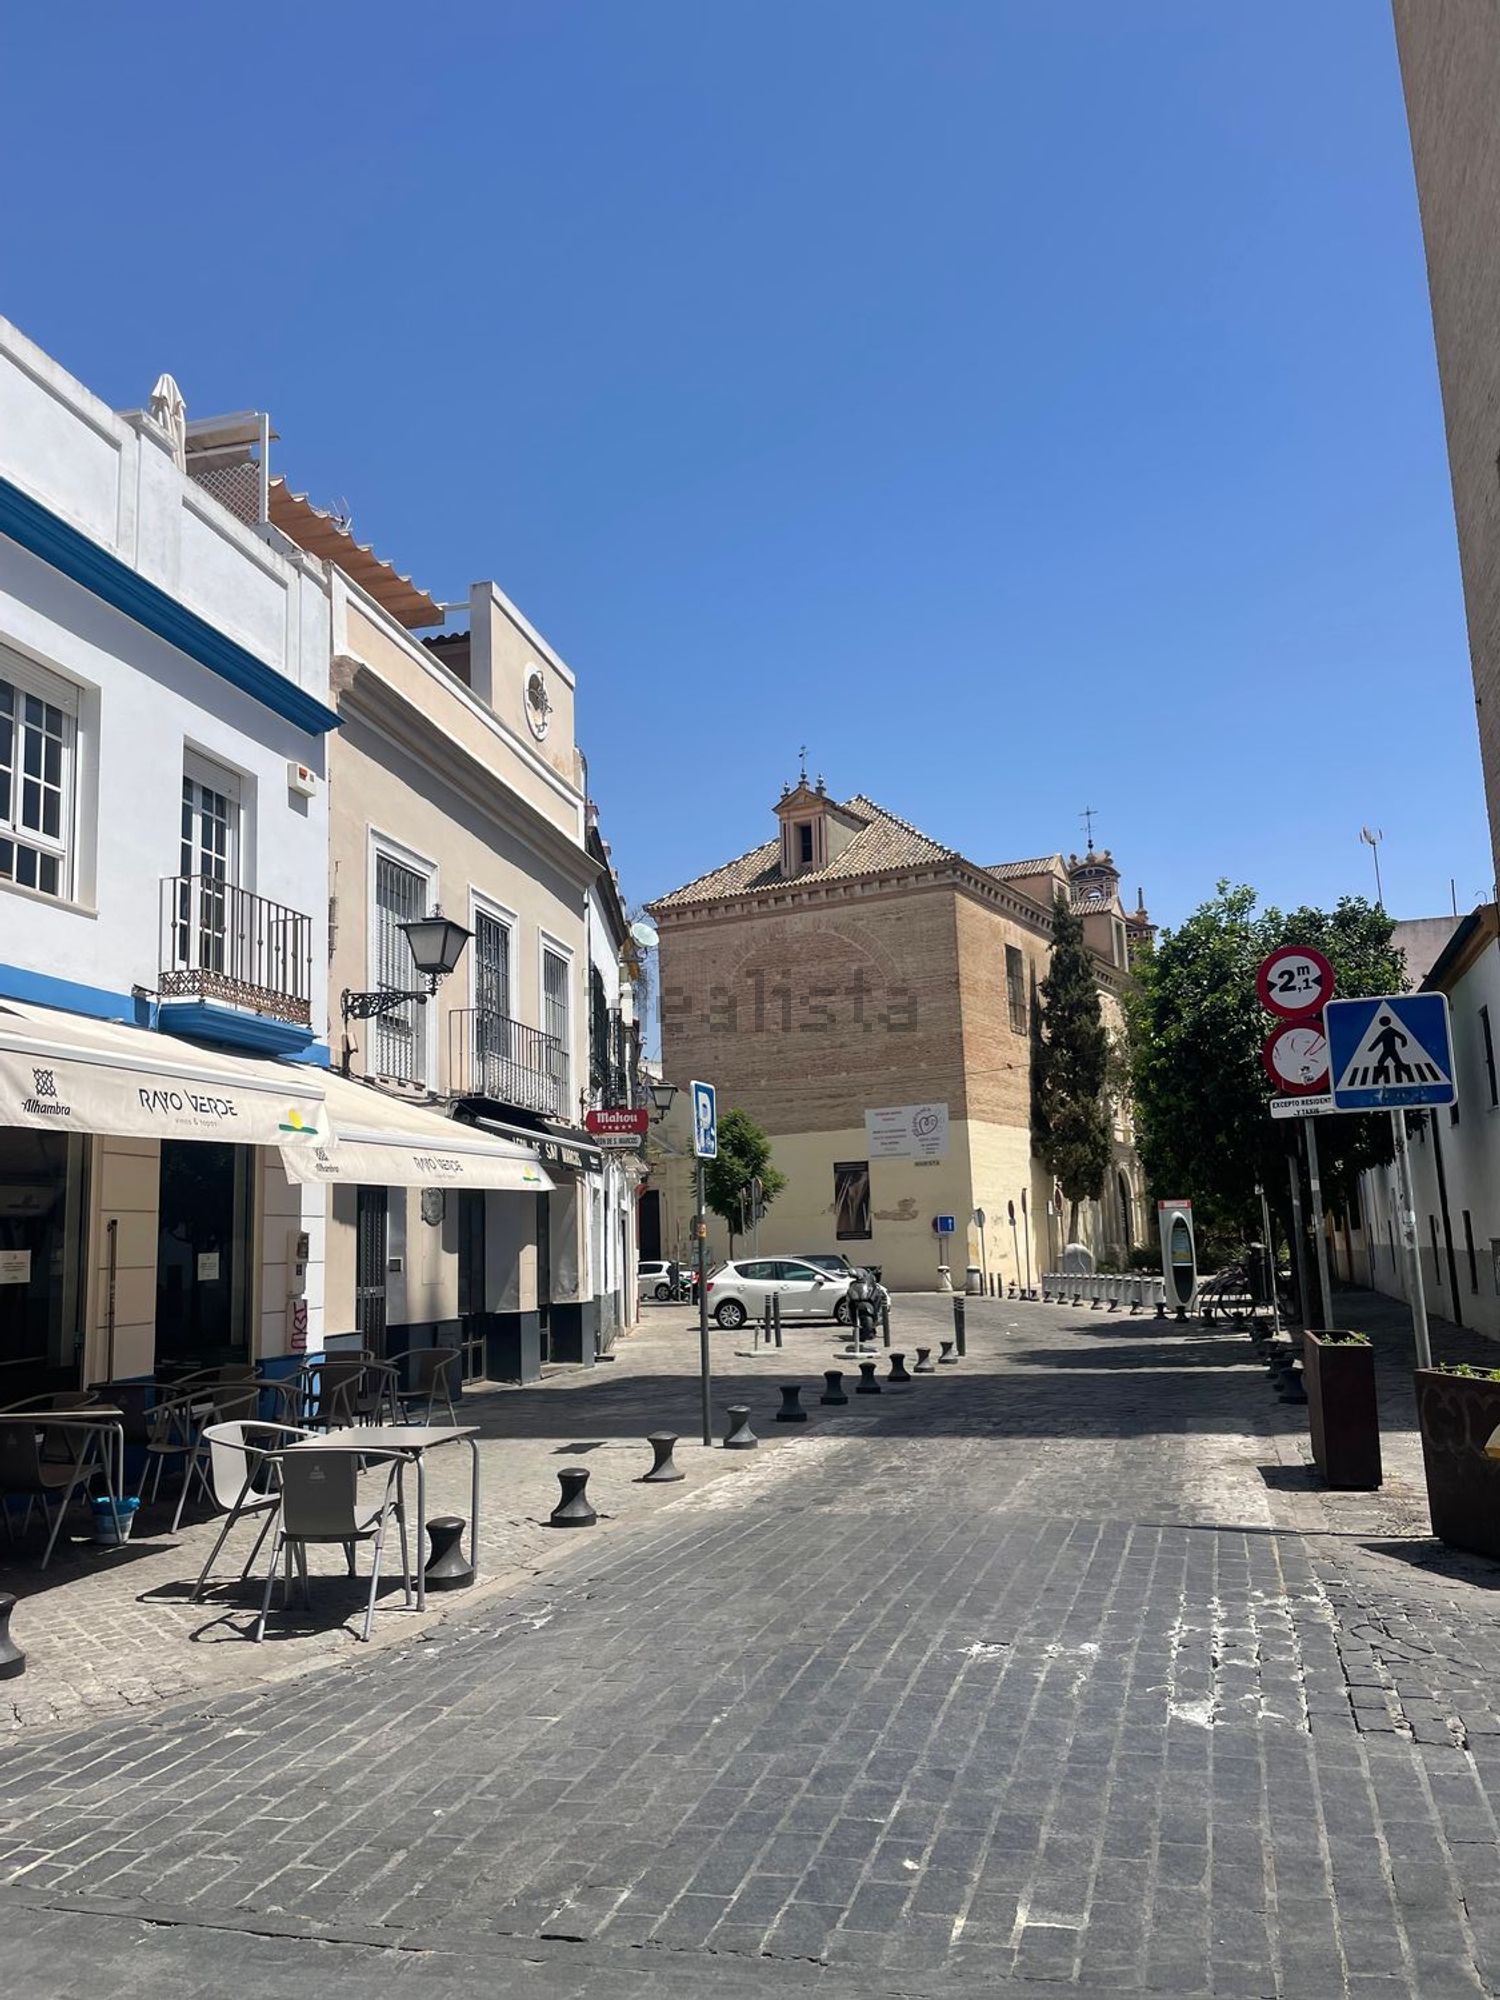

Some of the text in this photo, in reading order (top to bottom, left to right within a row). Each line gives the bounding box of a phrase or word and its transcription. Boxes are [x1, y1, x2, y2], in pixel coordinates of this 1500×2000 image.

[21, 1098, 71, 1116] Alhambra
[138, 1088, 238, 1119] RAYO VERDE
[1272, 1099, 1300, 1109] EXCEPTO
[597, 1111, 638, 1123] Mahou
